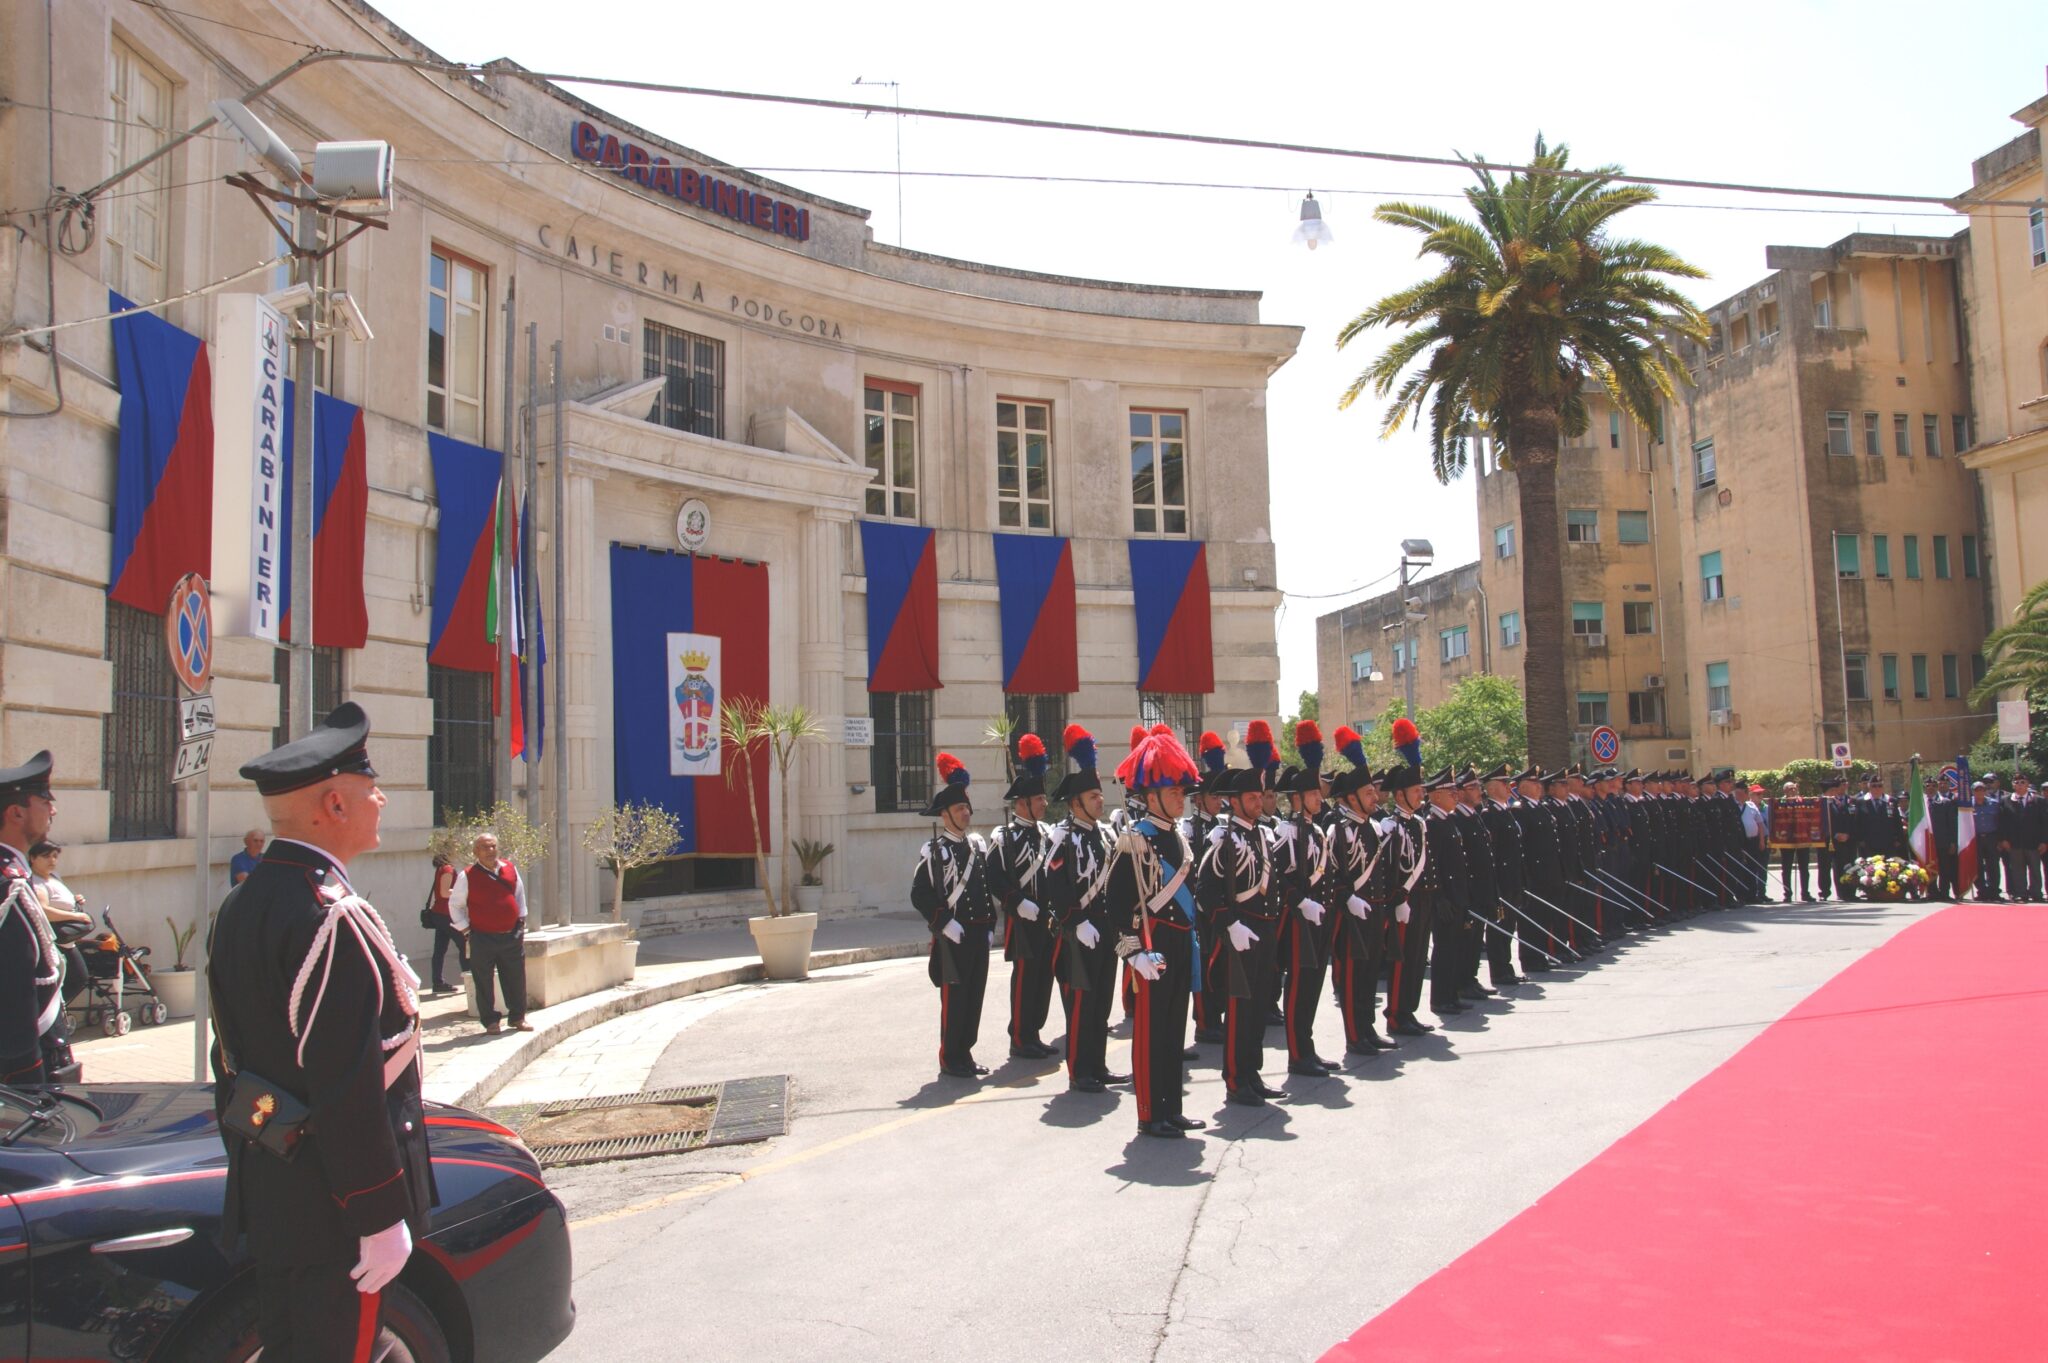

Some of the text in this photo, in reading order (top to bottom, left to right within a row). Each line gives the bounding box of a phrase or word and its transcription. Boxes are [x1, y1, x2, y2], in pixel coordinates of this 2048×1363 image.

[571, 120, 810, 242] CARABINIERI
[538, 224, 842, 340] CASERMA PODGORA
[256, 357, 278, 628] CARABINIERI
